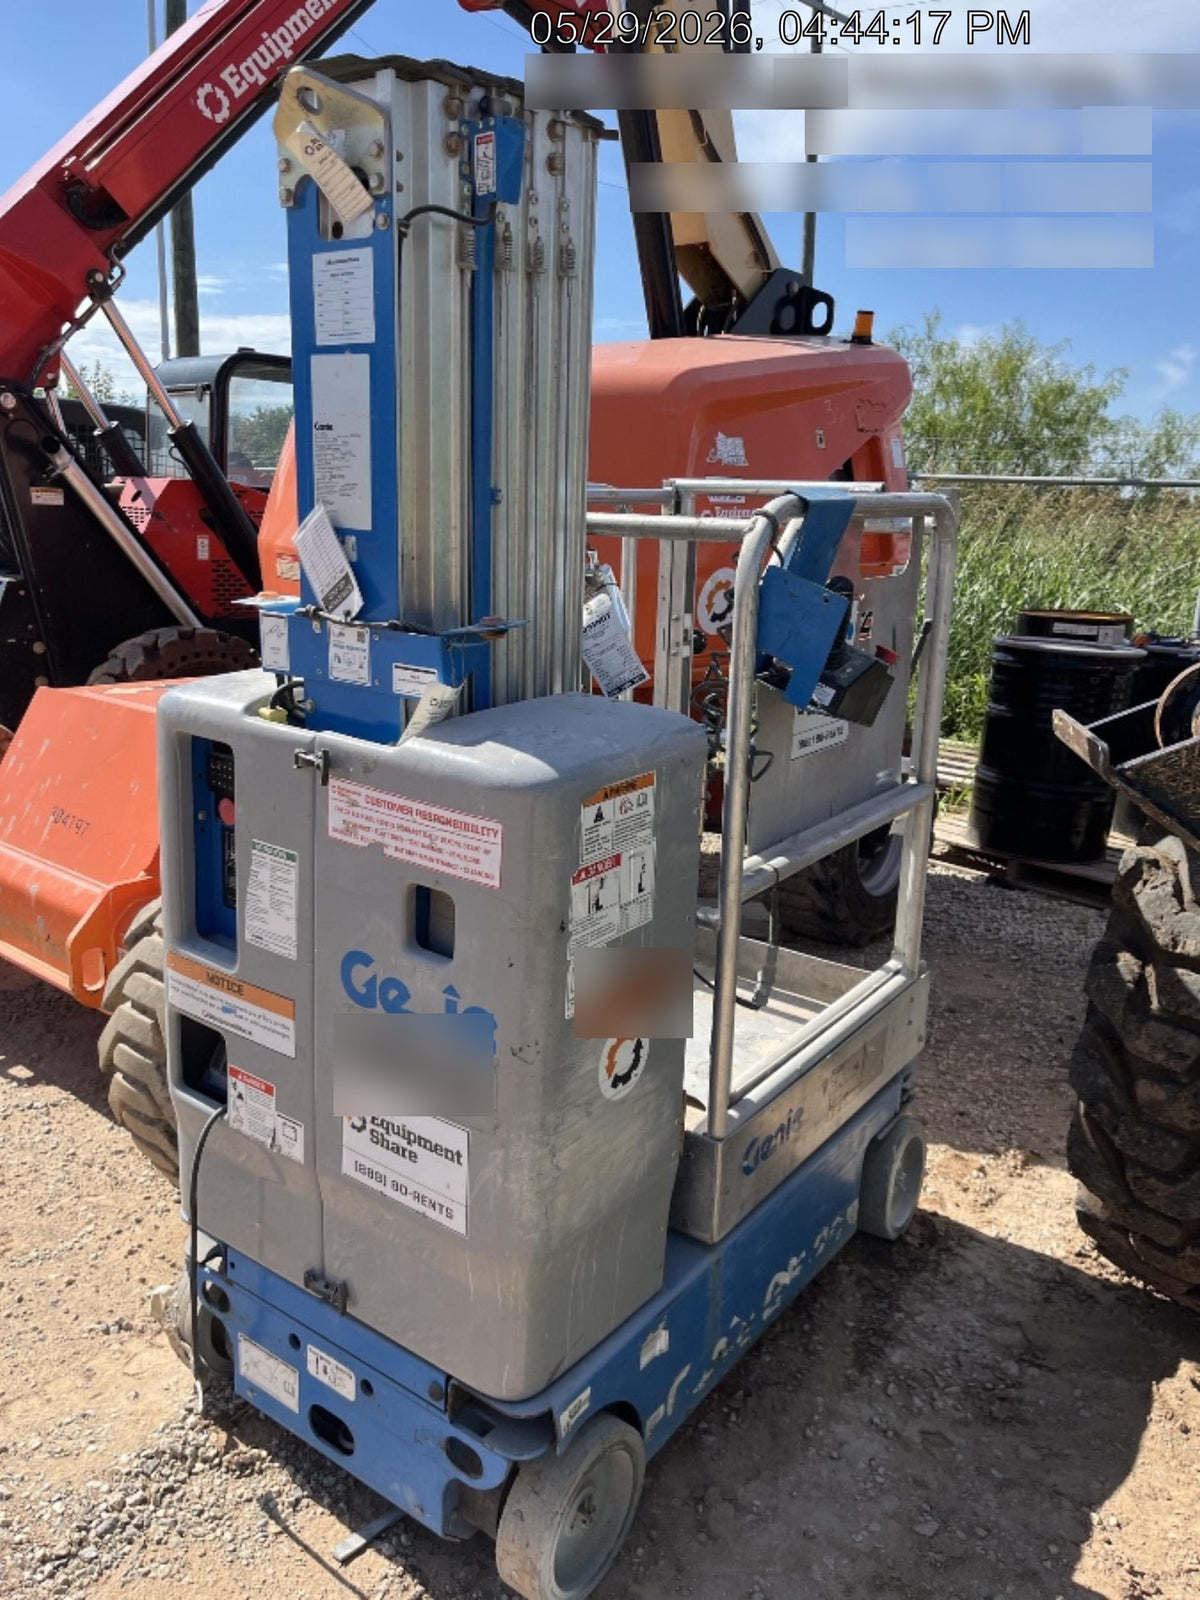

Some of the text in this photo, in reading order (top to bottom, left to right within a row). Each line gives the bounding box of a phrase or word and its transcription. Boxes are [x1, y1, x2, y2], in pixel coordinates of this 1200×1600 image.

[364, 794, 414, 817] CUSTOMER
[206, 972, 245, 997] NOTICE
[369, 1128, 418, 1163] Share
[370, 1116, 463, 1166] Equipment
